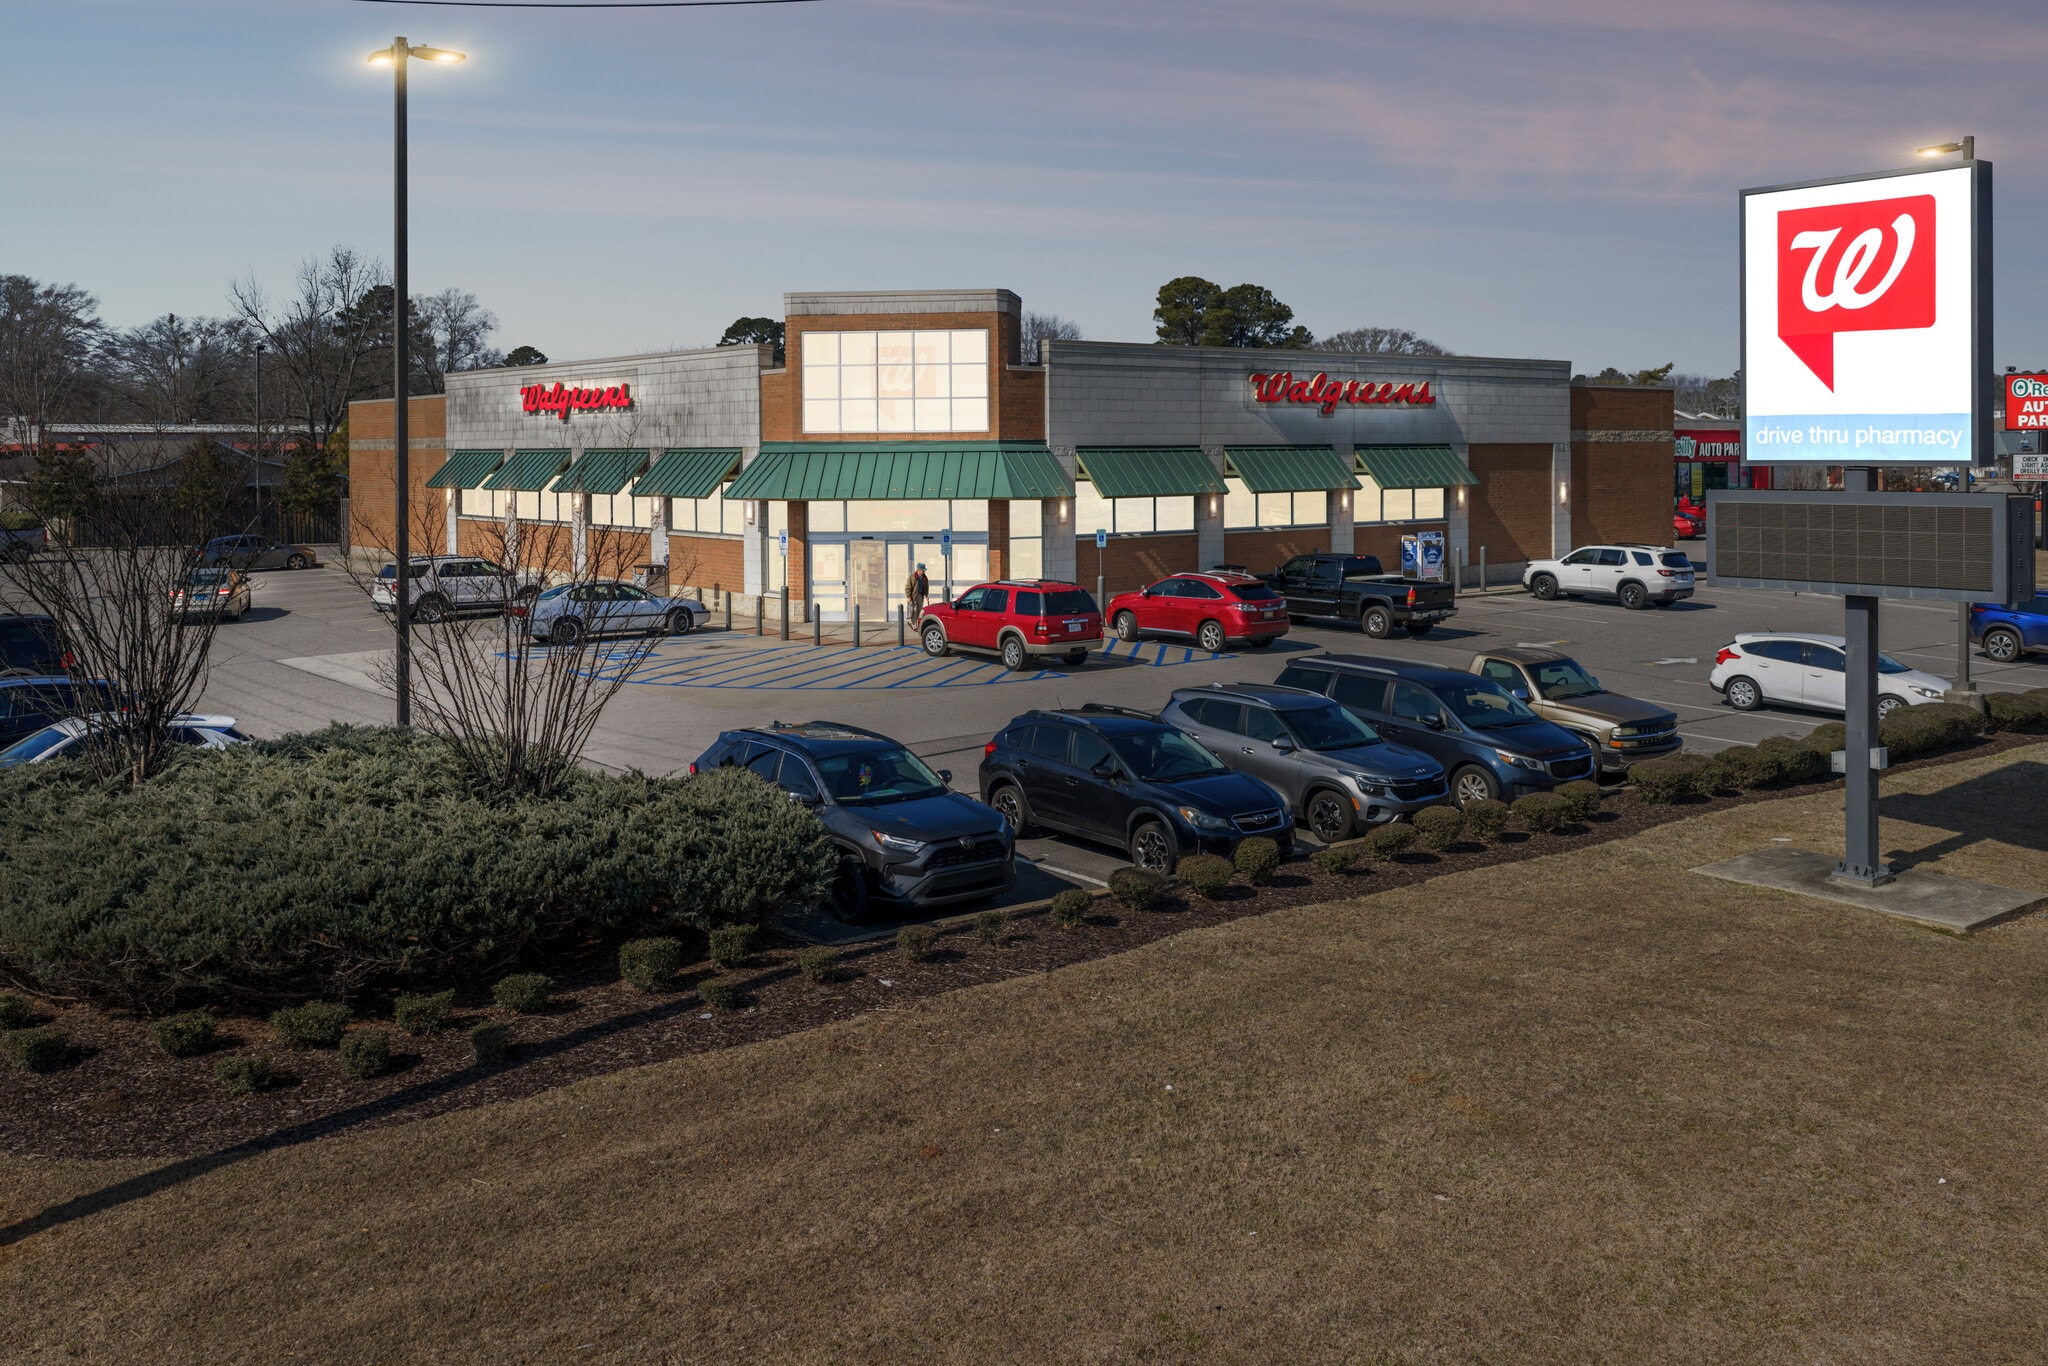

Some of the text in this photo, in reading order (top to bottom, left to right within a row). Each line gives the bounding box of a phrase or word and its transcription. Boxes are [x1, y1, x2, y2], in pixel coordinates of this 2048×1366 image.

[1790, 213, 1916, 313] W
[1250, 371, 1436, 415] Walgreens
[2012, 378, 2048, 398] O'Re
[520, 381, 631, 420] Walgreens
[2017, 415, 2048, 427] PAR
[1674, 436, 1740, 459] eilly AUTO PAR
[1755, 425, 1963, 449] drive thru pharmacy
